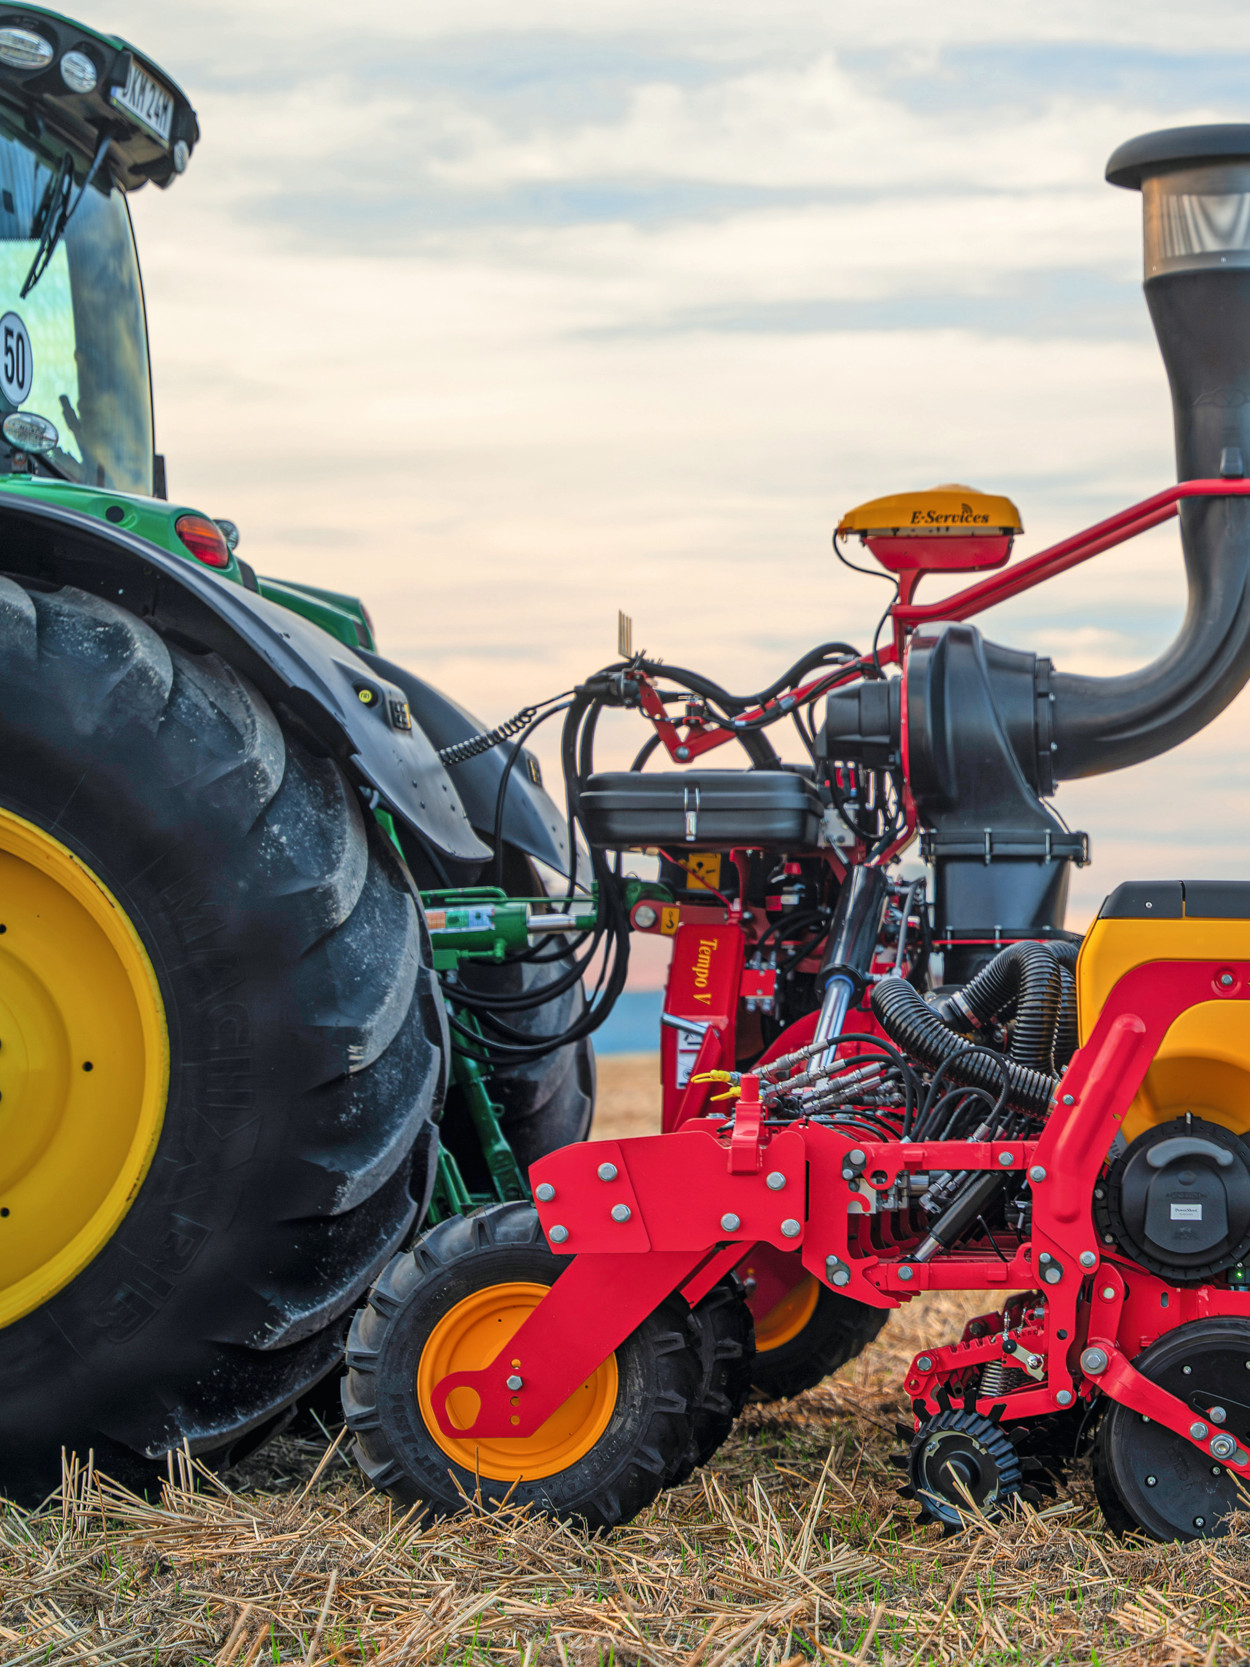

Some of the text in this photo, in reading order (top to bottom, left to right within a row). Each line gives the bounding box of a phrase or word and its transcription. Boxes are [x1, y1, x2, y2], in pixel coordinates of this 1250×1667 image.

[4, 325, 25, 390] 50
[910, 509, 990, 525] E-Services
[692, 939, 718, 1005] Tempo V
